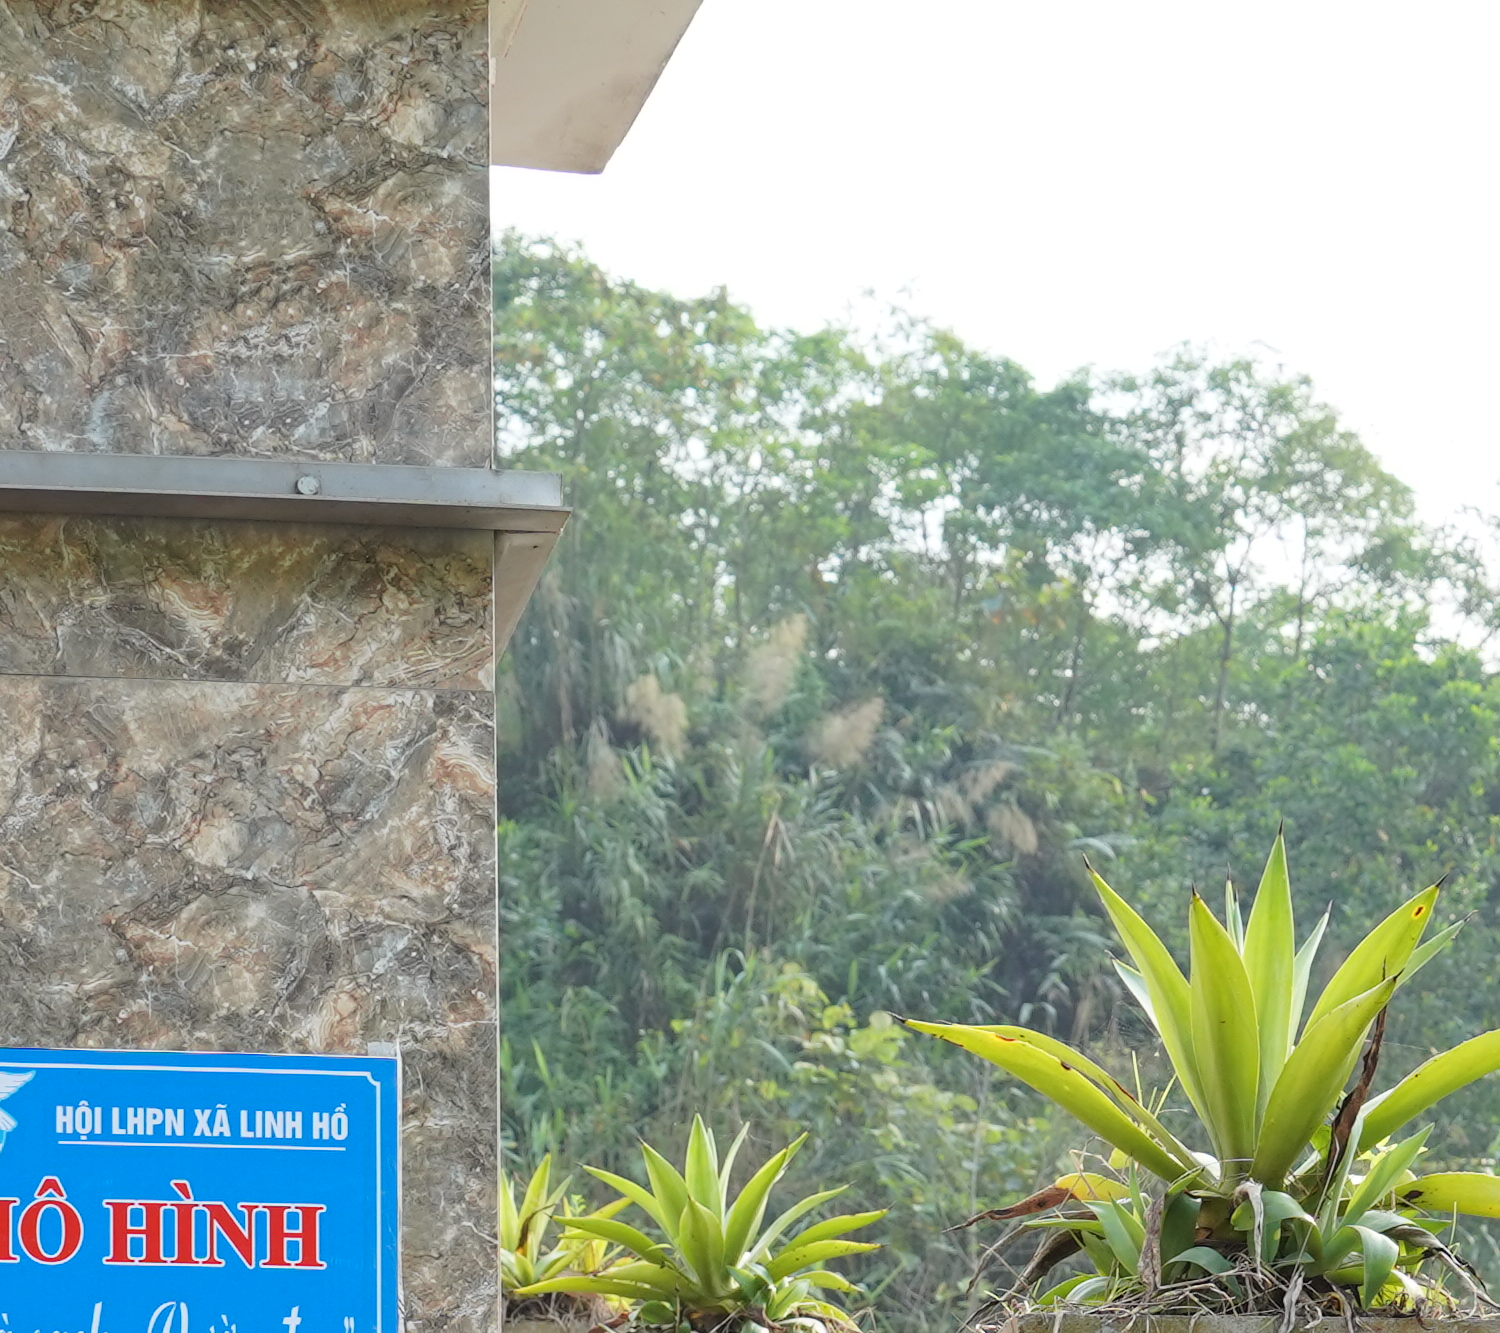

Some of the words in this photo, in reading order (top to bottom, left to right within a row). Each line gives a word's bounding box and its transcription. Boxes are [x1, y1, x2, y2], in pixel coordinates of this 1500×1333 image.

[55, 1100, 101, 1140] HỘI
[111, 1106, 185, 1137] LHPN
[193, 1104, 231, 1137] XÃ
[240, 1110, 302, 1139] LINH
[312, 1103, 348, 1141] HỒ
[103, 1179, 327, 1269] HÌNH
